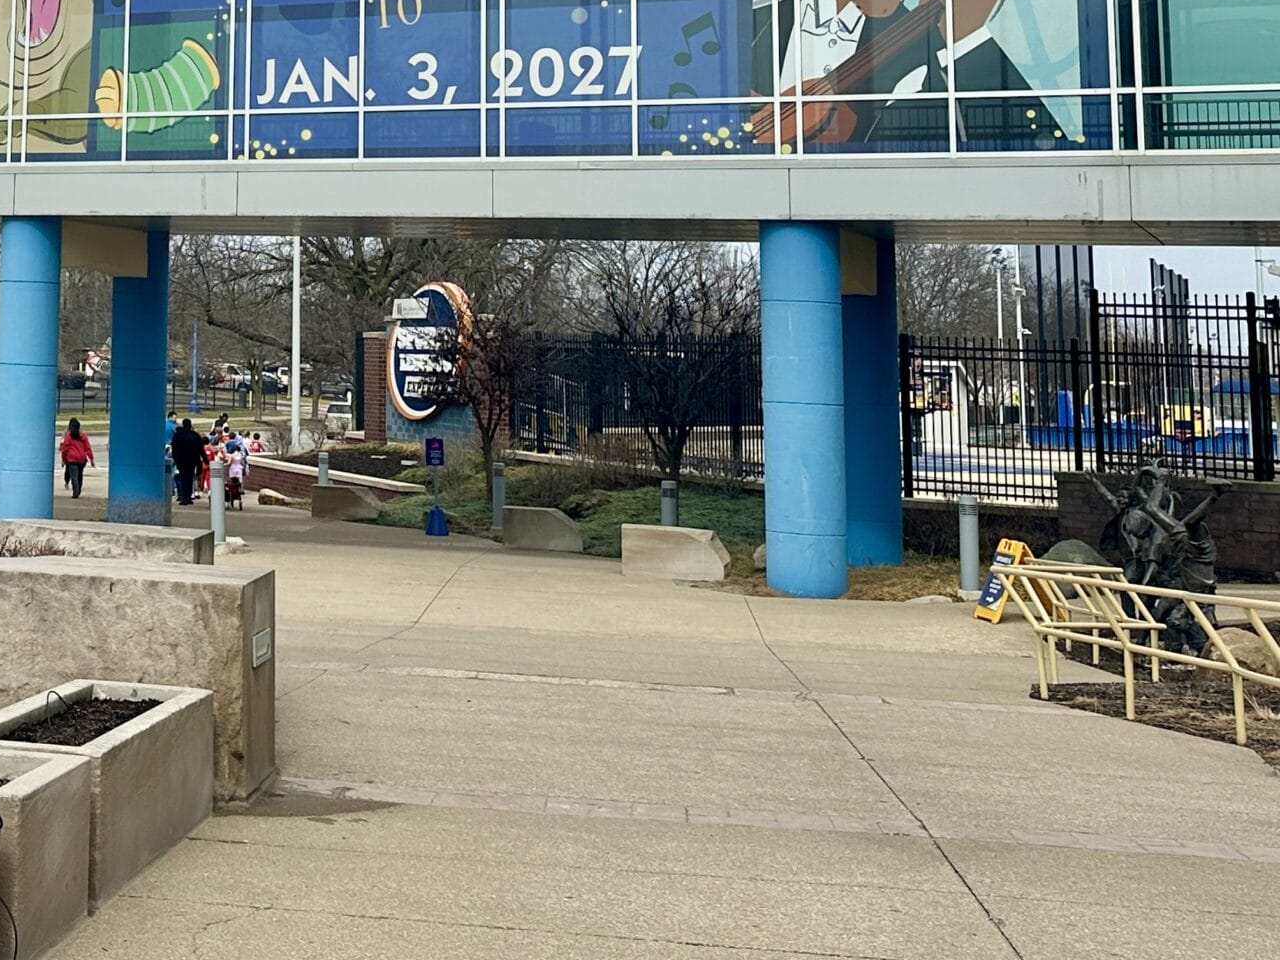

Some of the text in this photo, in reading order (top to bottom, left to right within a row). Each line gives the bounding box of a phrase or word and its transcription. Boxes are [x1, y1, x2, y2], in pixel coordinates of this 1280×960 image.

[256, 44, 644, 105] JAN. 3, 2027
